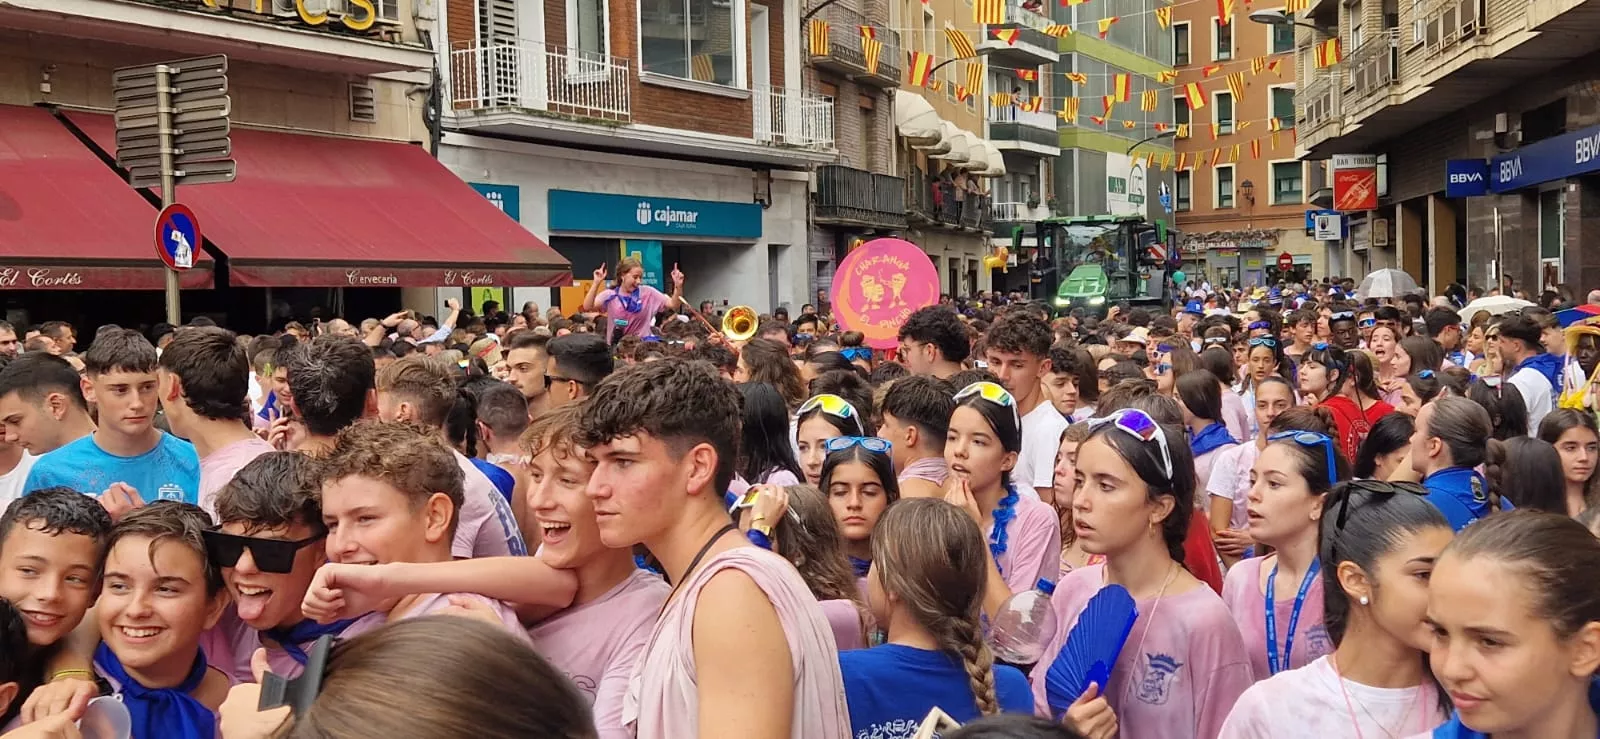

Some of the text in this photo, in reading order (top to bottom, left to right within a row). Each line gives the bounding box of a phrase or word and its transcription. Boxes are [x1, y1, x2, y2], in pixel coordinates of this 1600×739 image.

[1450, 172, 1483, 184] BBVA
[1499, 154, 1523, 183] BBVA
[654, 205, 699, 227] cajamar
[0, 267, 83, 287] El Cortés
[444, 270, 457, 284] El
[859, 307, 911, 329] EL PINCHO
